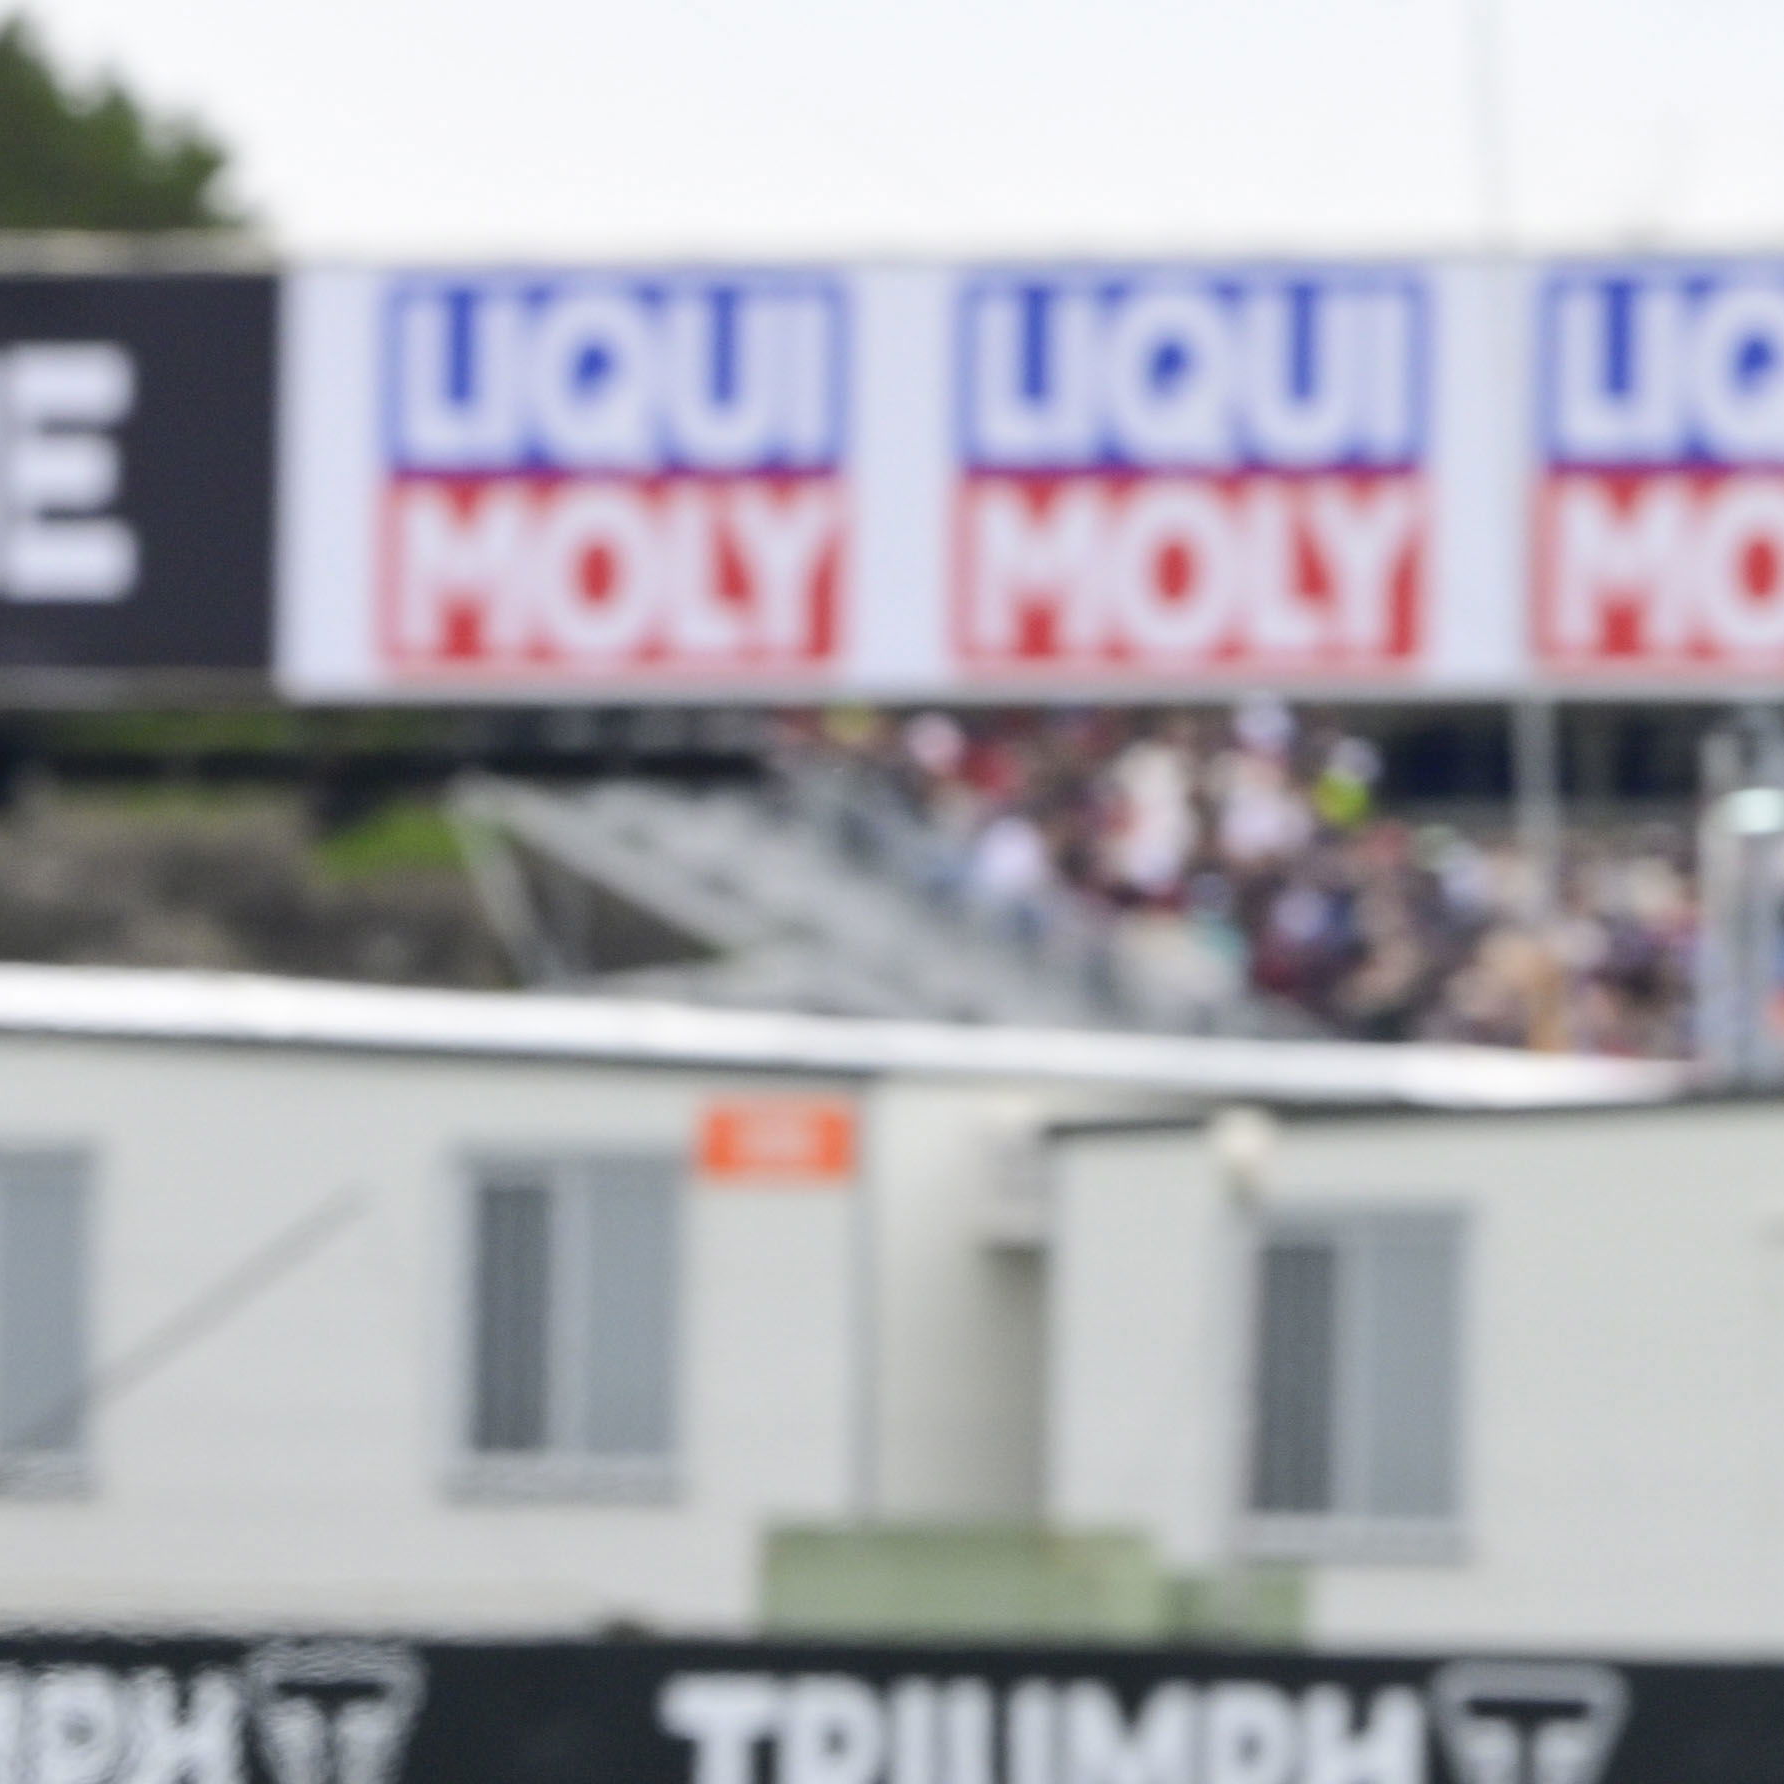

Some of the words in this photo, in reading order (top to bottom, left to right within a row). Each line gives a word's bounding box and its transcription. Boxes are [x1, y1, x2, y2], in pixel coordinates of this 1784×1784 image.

[391, 275, 839, 468] LIQUI
[966, 275, 1421, 468] LIQUI
[1546, 270, 1784, 465] LIQ
[386, 475, 836, 670] MOLY
[958, 475, 1421, 670] MOLY
[1536, 472, 1784, 665] MO
